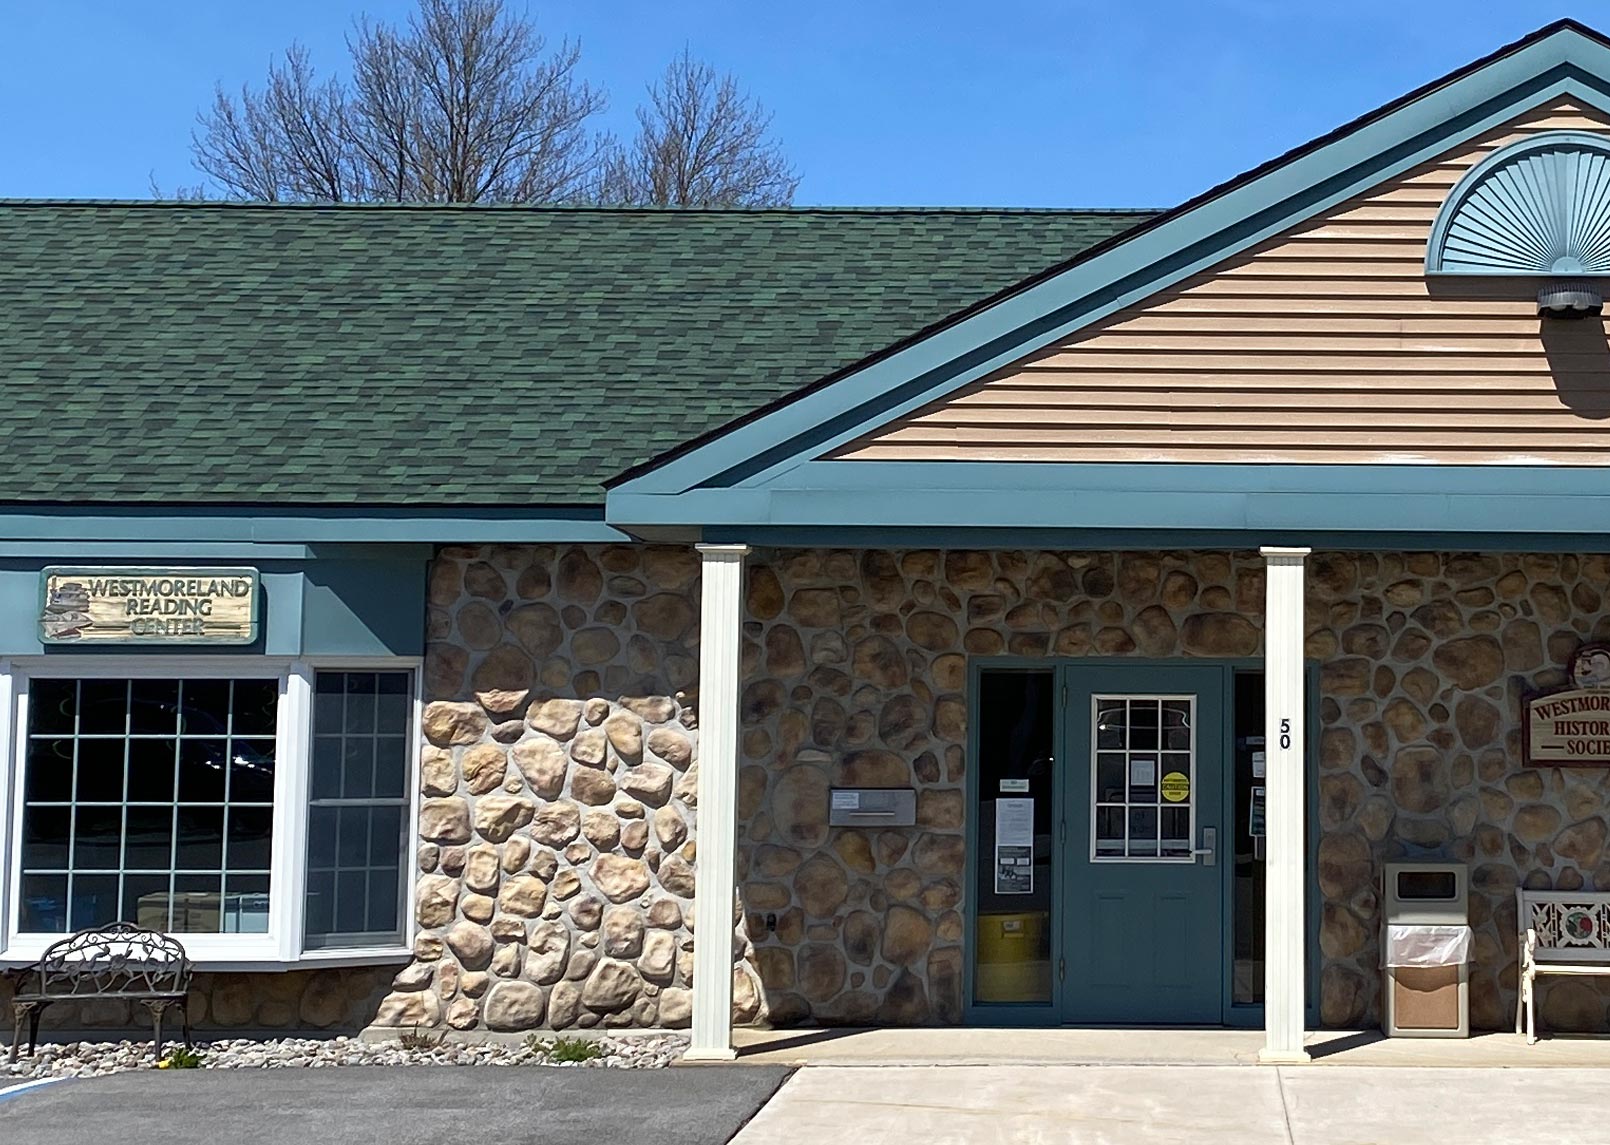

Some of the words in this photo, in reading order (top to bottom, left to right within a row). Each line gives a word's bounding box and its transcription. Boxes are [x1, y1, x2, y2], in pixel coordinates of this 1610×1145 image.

[88, 579, 249, 597] WESTMORELAND
[125, 598, 212, 616] READING
[129, 617, 206, 636] CENTER
[1279, 718, 1290, 750] 50
